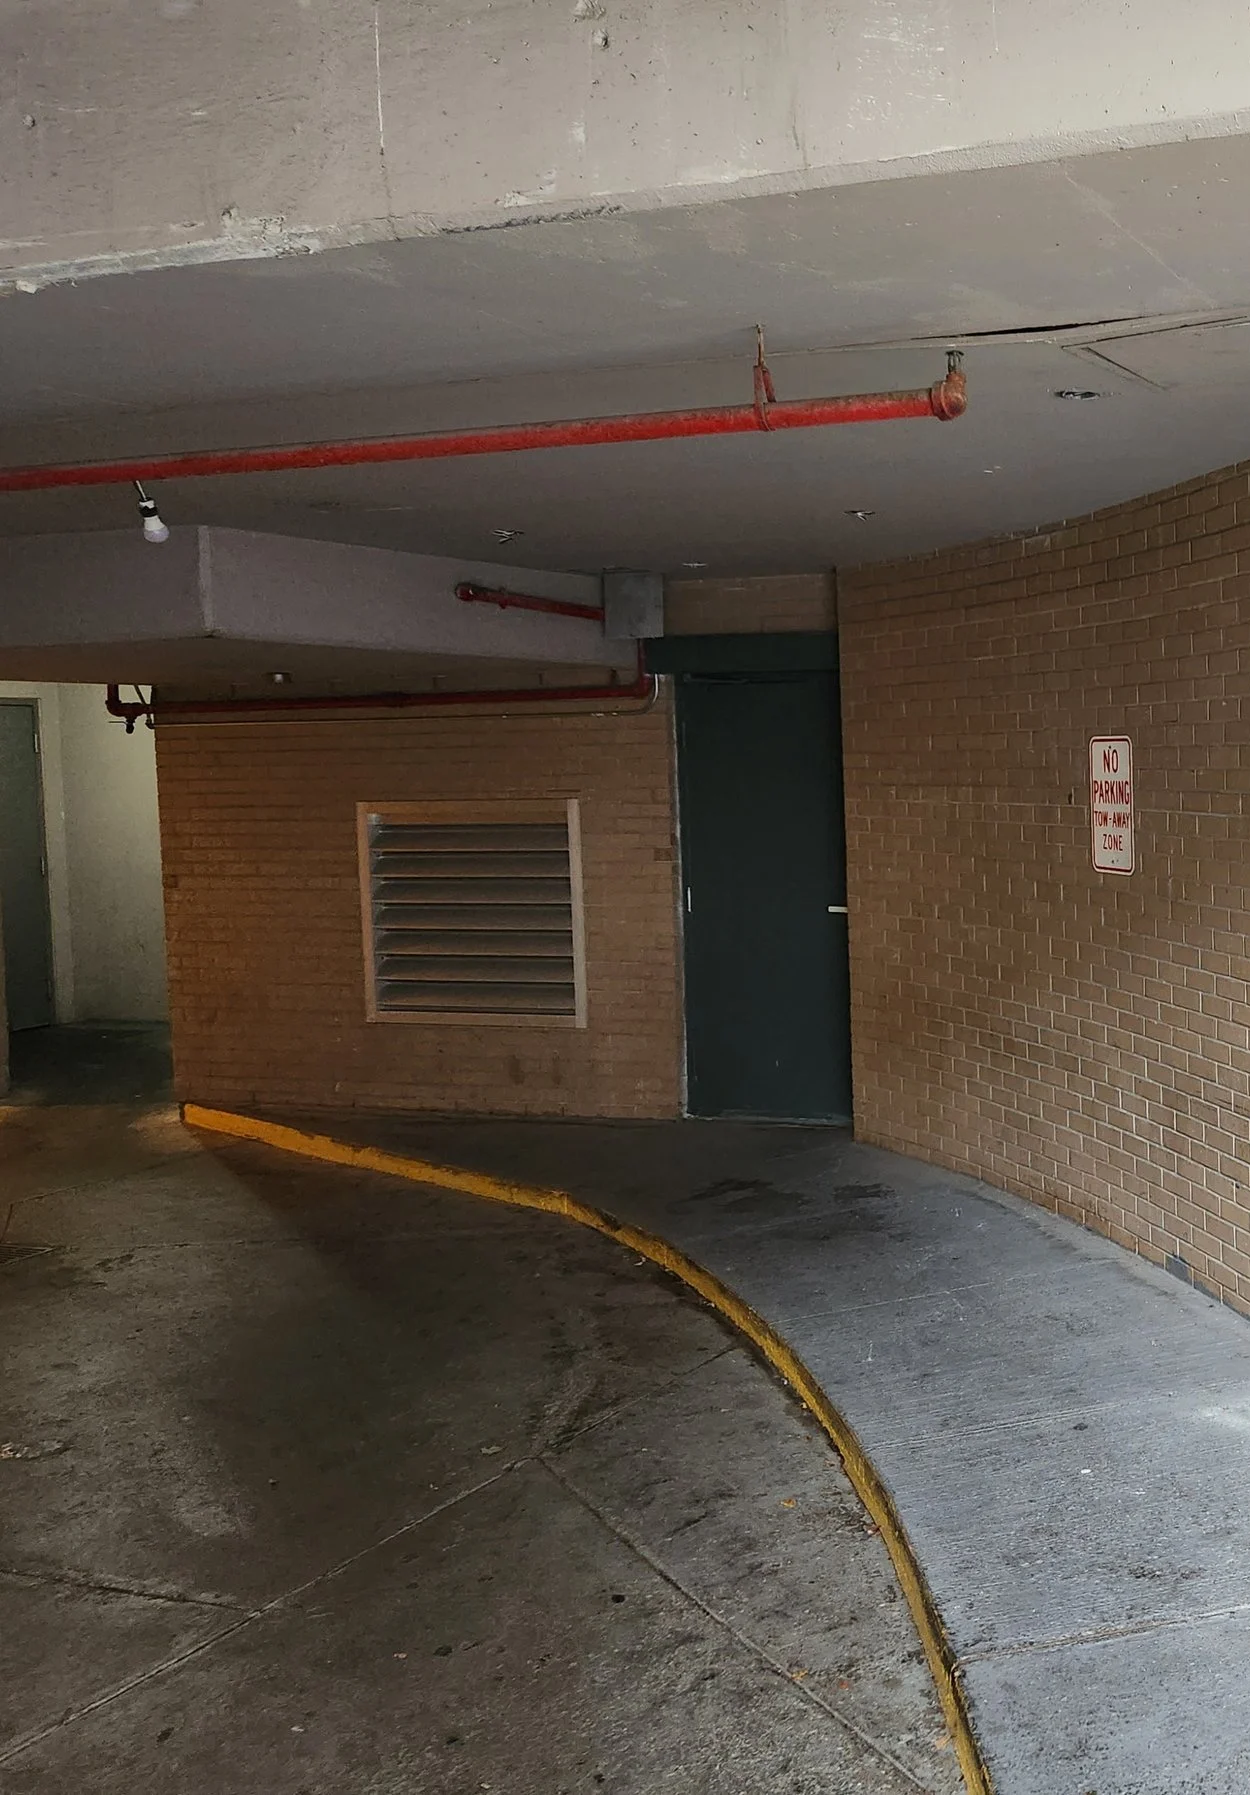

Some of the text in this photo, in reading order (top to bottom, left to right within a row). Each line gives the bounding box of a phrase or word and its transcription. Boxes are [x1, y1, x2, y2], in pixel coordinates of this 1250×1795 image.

[1103, 749, 1118, 773] NO
[1093, 780, 1130, 805] PARKING
[1094, 811, 1130, 829] TOW-AWAY
[1102, 833, 1123, 851] ZONE
